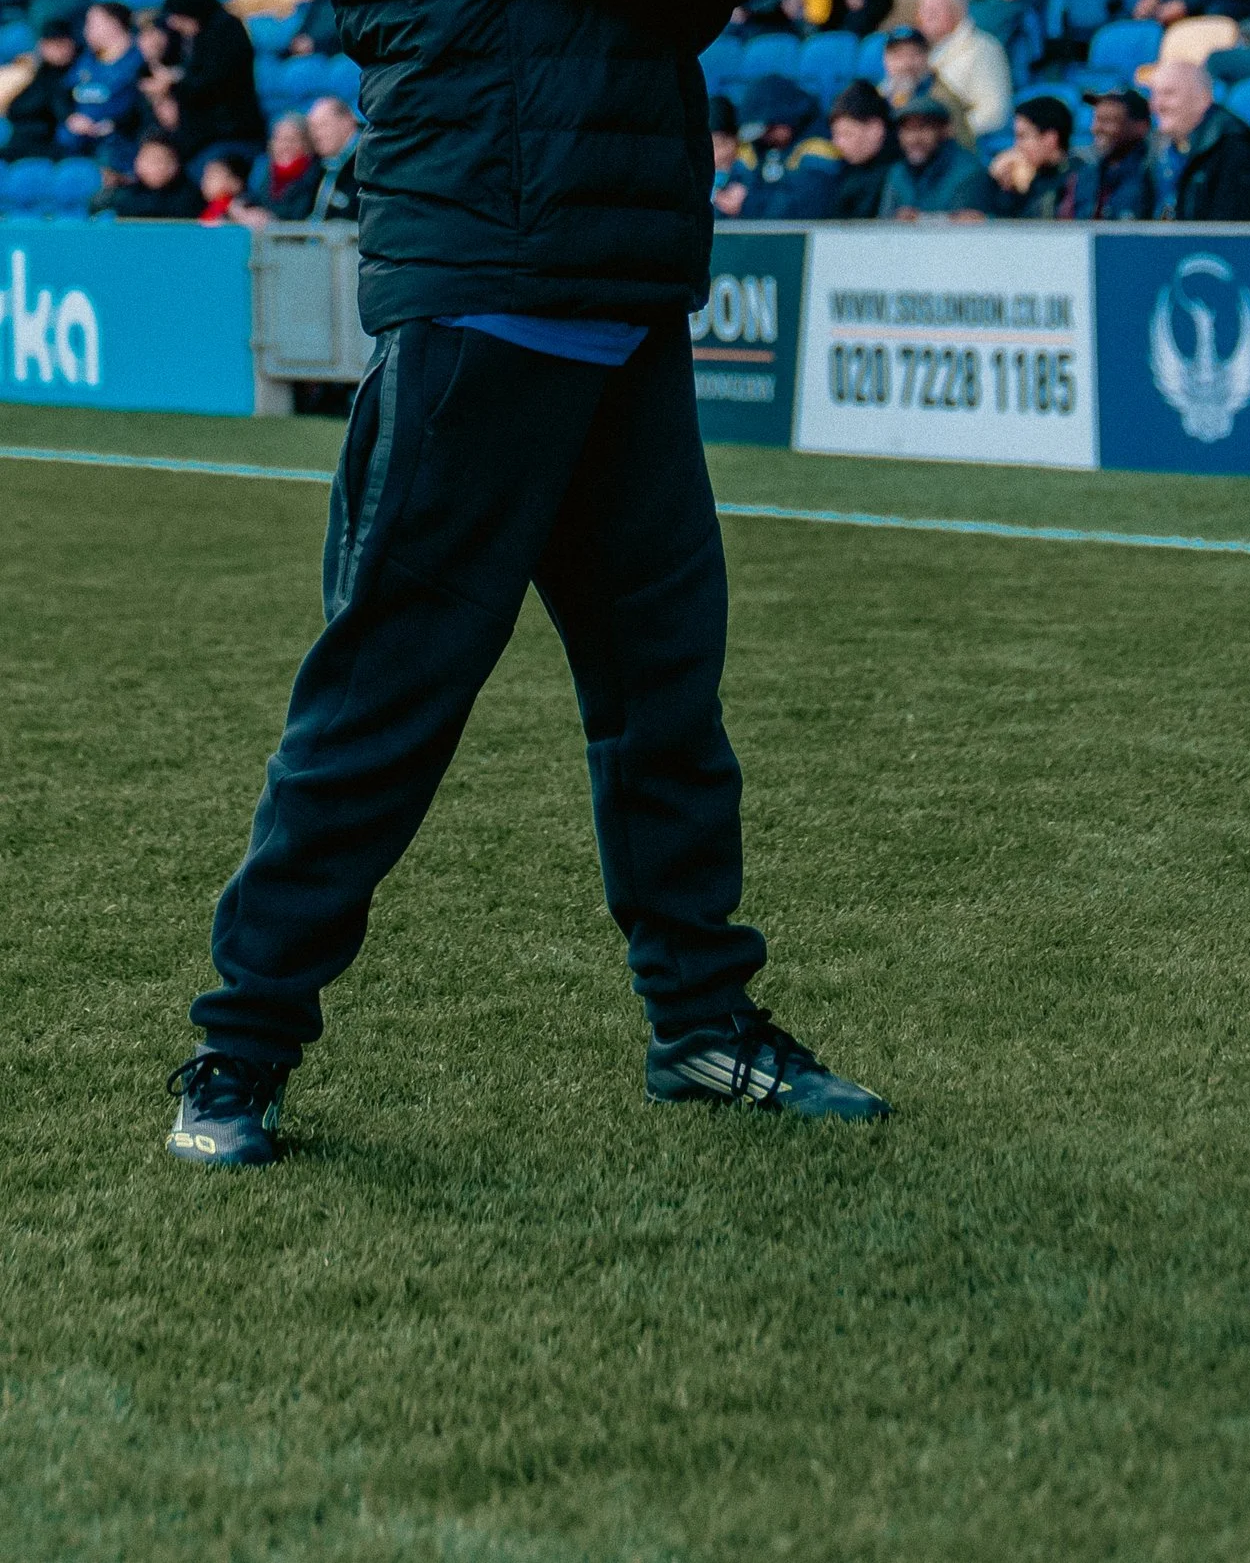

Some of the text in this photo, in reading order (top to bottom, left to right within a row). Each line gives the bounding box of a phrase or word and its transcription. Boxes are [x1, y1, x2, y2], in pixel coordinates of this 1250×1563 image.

[0, 249, 100, 386] ka
[830, 342, 890, 406] 020
[897, 344, 981, 410] 7228
[990, 347, 1077, 415] 1185
